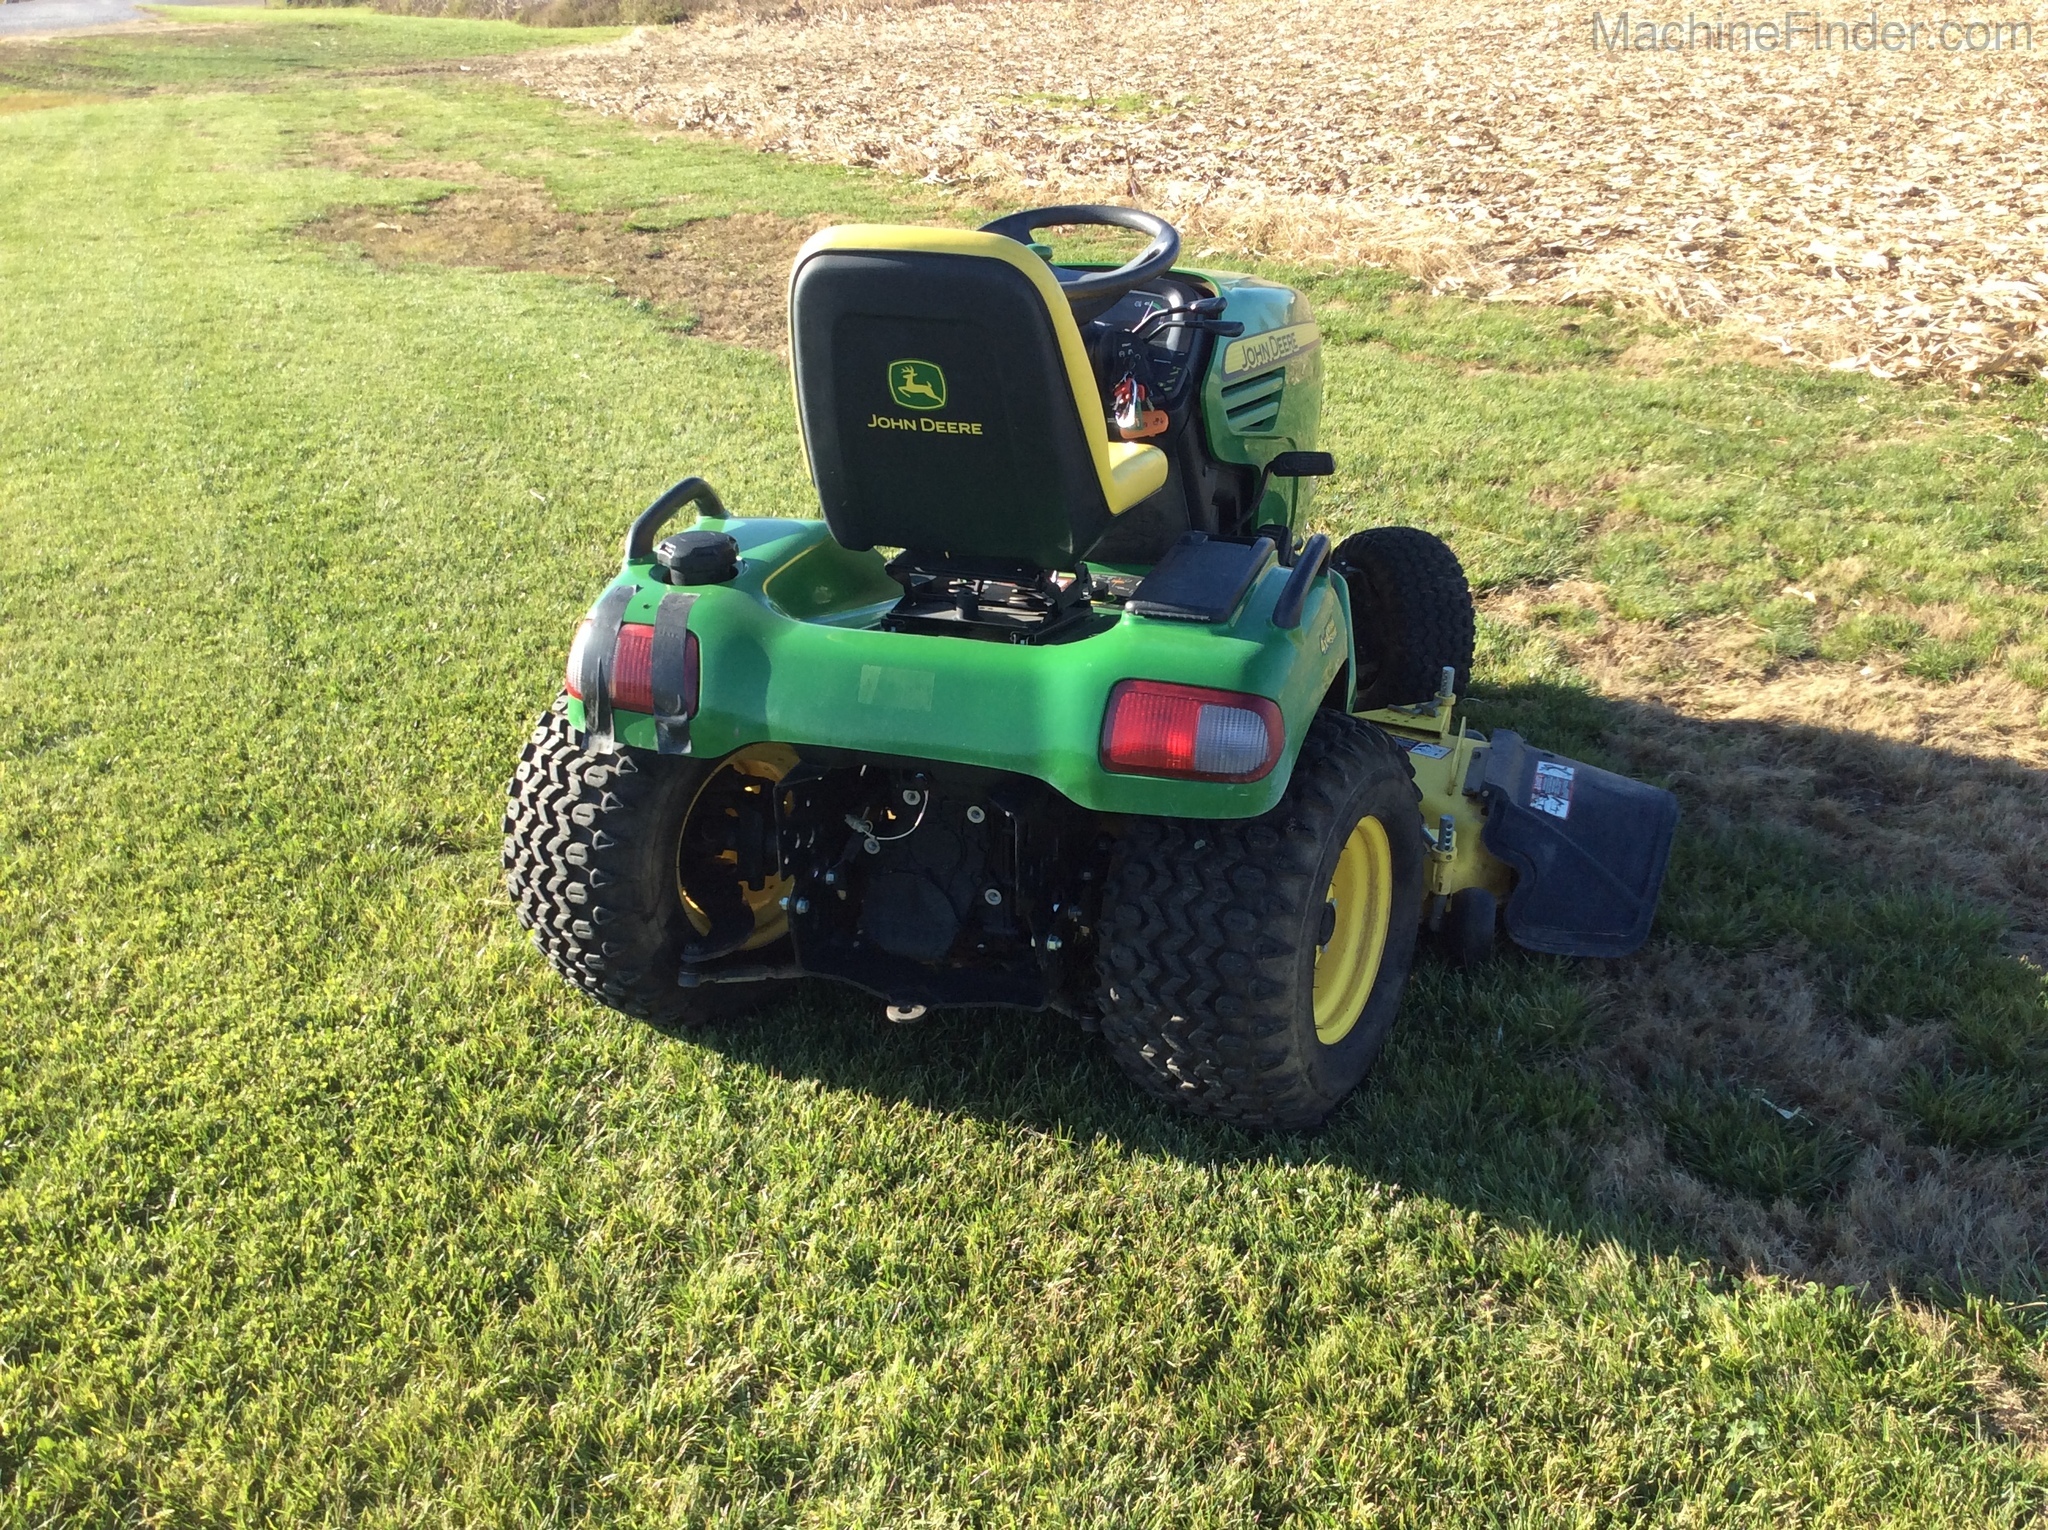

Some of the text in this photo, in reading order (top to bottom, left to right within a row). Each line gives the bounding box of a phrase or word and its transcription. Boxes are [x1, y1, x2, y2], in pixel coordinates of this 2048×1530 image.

[1242, 332, 1299, 369] JOHN DEERE
[867, 414, 983, 435] JOHN DEERE
